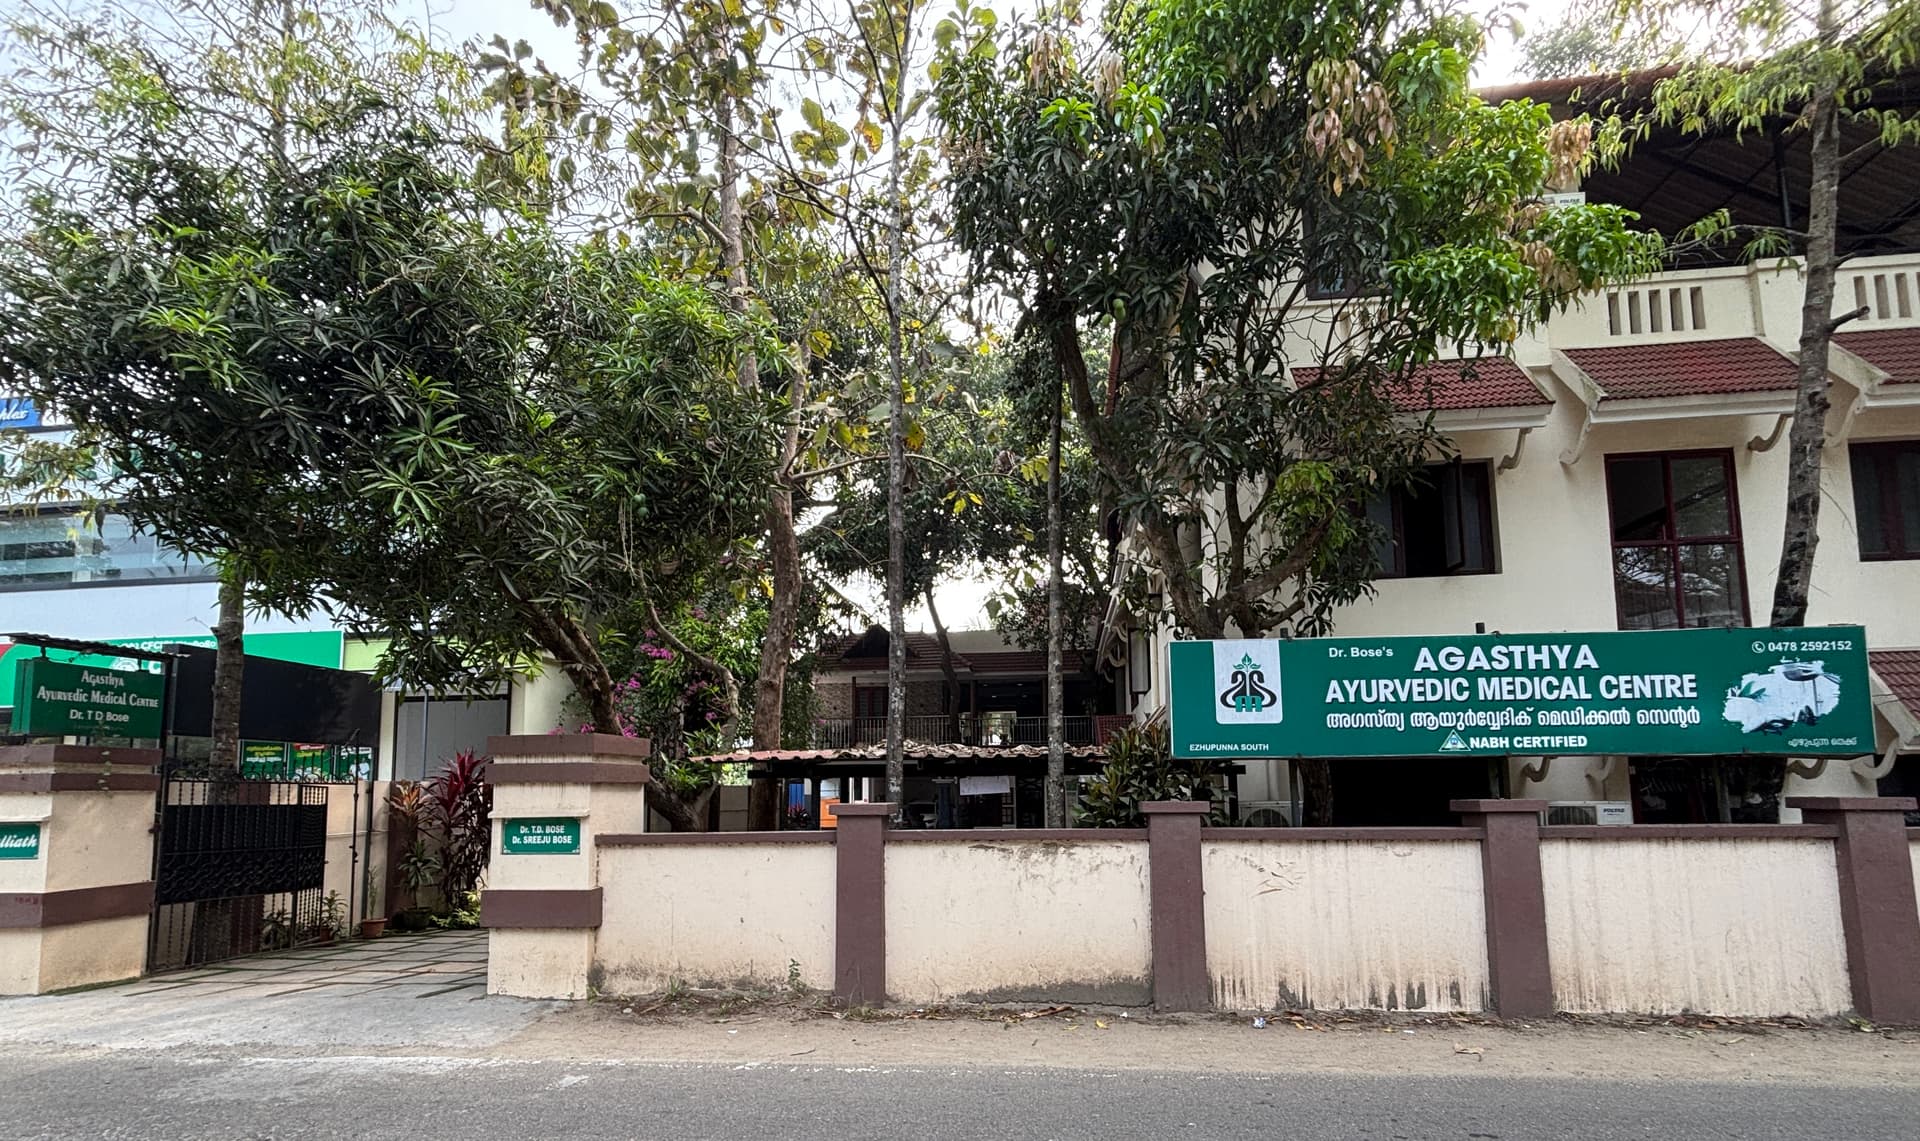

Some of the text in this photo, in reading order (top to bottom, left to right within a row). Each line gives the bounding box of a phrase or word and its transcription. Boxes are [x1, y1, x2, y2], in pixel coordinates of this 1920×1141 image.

[1328, 646, 1393, 658] Dr. Bose's
[1768, 640, 1852, 652] 0478 2592152
[1414, 644, 1600, 672] AGASTHYA
[1326, 674, 1698, 704] AYURVEDIC MEDICAL CENTRE
[69, 709, 130, 722] Dr. T D Bose
[1326, 709, 1405, 732] അഗസ്ത്യ
[1538, 706, 1631, 726] മെഡിക്കൽ
[1189, 743, 1270, 752] EZHUPUNNA SOUTH
[1469, 735, 1588, 749] NABH CERTIFIED
[520, 825, 530, 834] Dr.
[545, 825, 566, 834] BOSE
[0, 833, 38, 848] lliath
[512, 835, 573, 844] Dr. SREEJU BOSE
